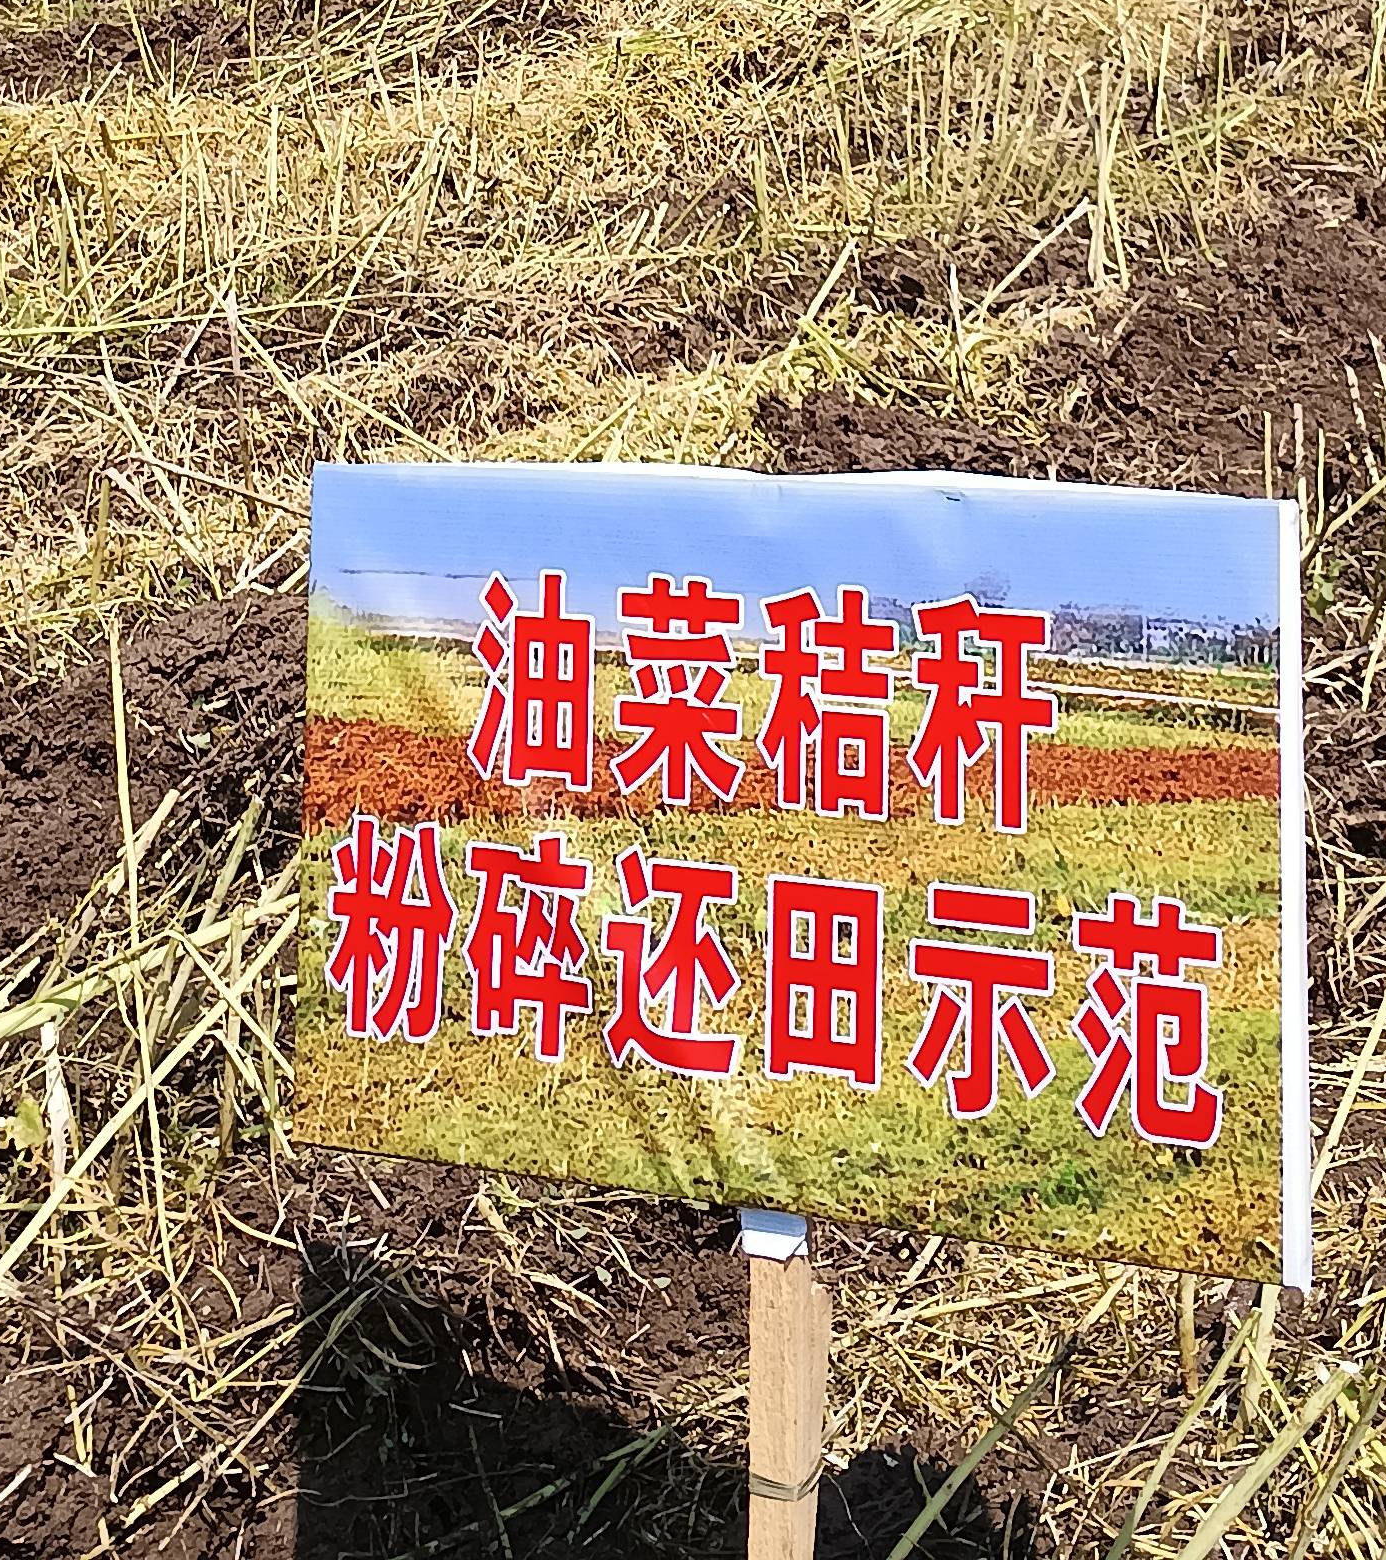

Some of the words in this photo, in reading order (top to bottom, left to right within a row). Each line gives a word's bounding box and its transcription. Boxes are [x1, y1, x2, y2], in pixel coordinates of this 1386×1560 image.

[472, 573, 1054, 830] 油菜秸秆
[329, 819, 1219, 1145] 粉碎还田示范
